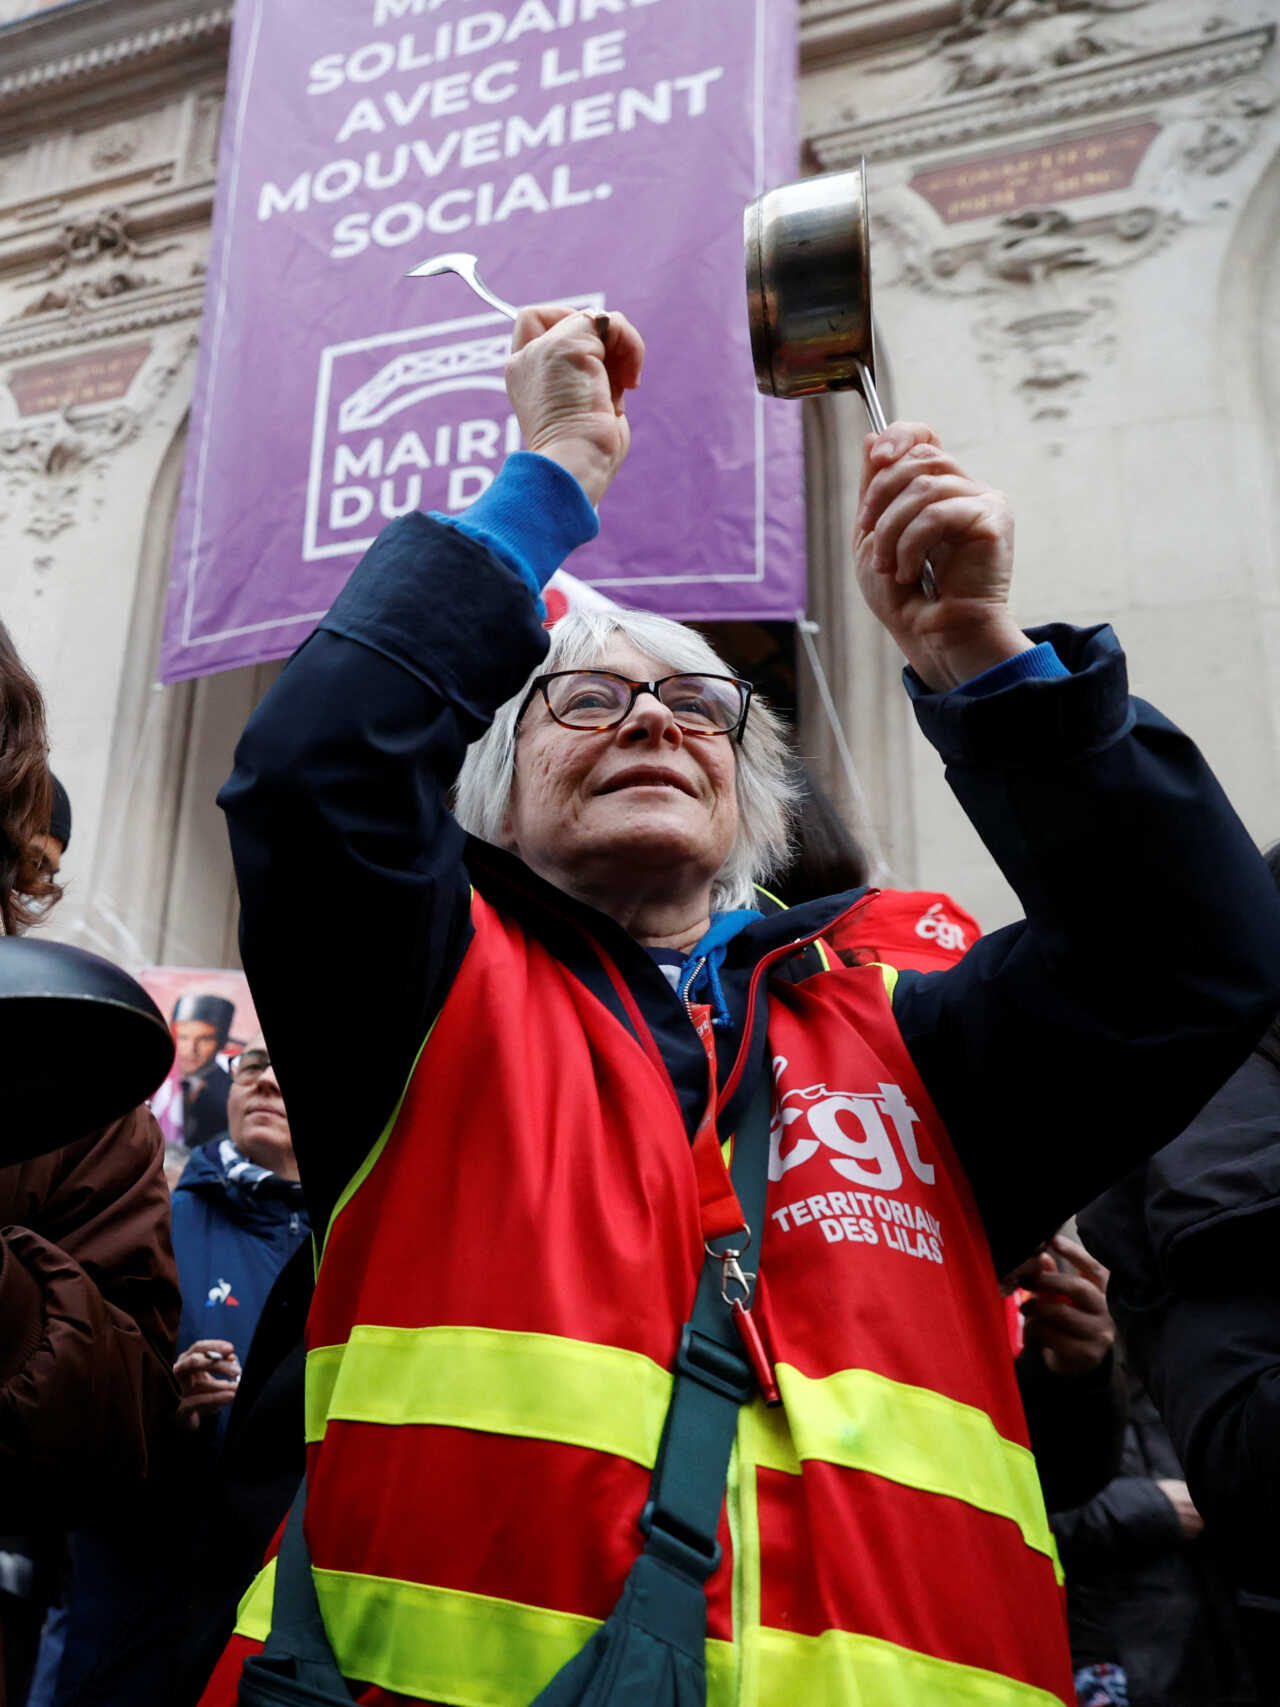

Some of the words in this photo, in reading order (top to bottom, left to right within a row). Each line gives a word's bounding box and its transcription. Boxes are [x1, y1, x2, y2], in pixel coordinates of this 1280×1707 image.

[306, 0, 666, 96] SOLIDAI
[335, 60, 519, 143] AVEC
[540, 30, 627, 89] LE
[258, 67, 723, 222] MOUVEMENT
[330, 164, 612, 260] SOCIAL.
[329, 474, 422, 530] DU
[915, 915, 967, 951] cgt
[768, 1082, 936, 1191] cgt
[820, 1217, 879, 1244] DES
[882, 1222, 943, 1264] LILAS
